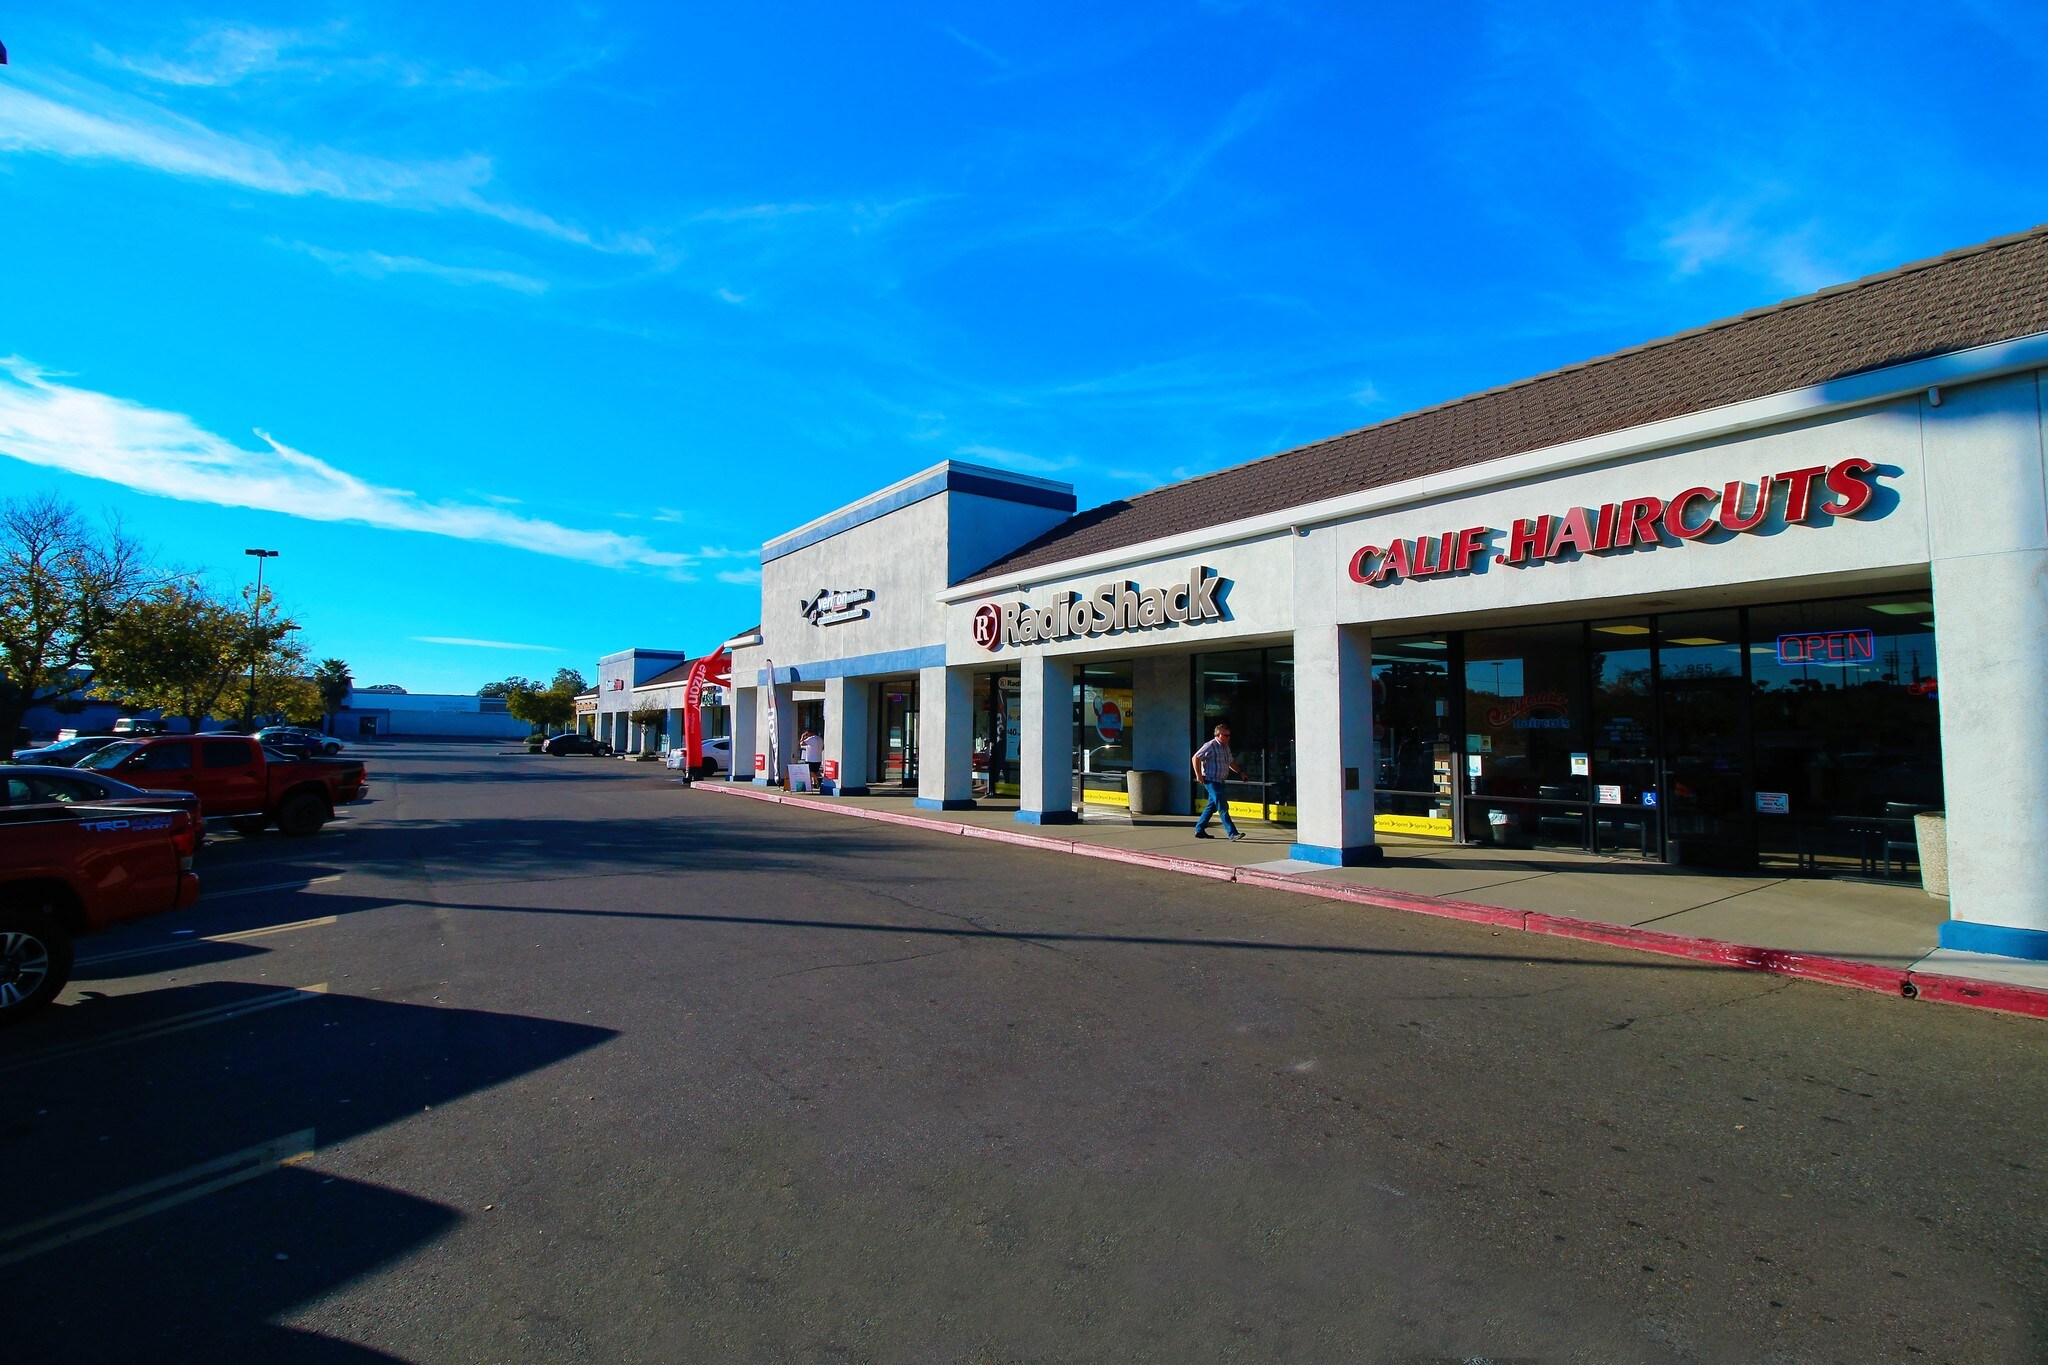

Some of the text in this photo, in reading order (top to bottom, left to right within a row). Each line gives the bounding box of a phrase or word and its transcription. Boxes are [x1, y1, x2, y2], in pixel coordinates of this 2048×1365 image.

[1000, 566, 1221, 645] RadioShack
[1781, 632, 1871, 662] OPEN
[688, 664, 707, 704] erizon
[1687, 664, 1712, 675] 855
[1485, 689, 1568, 727] California
[79, 820, 130, 832] TRD
